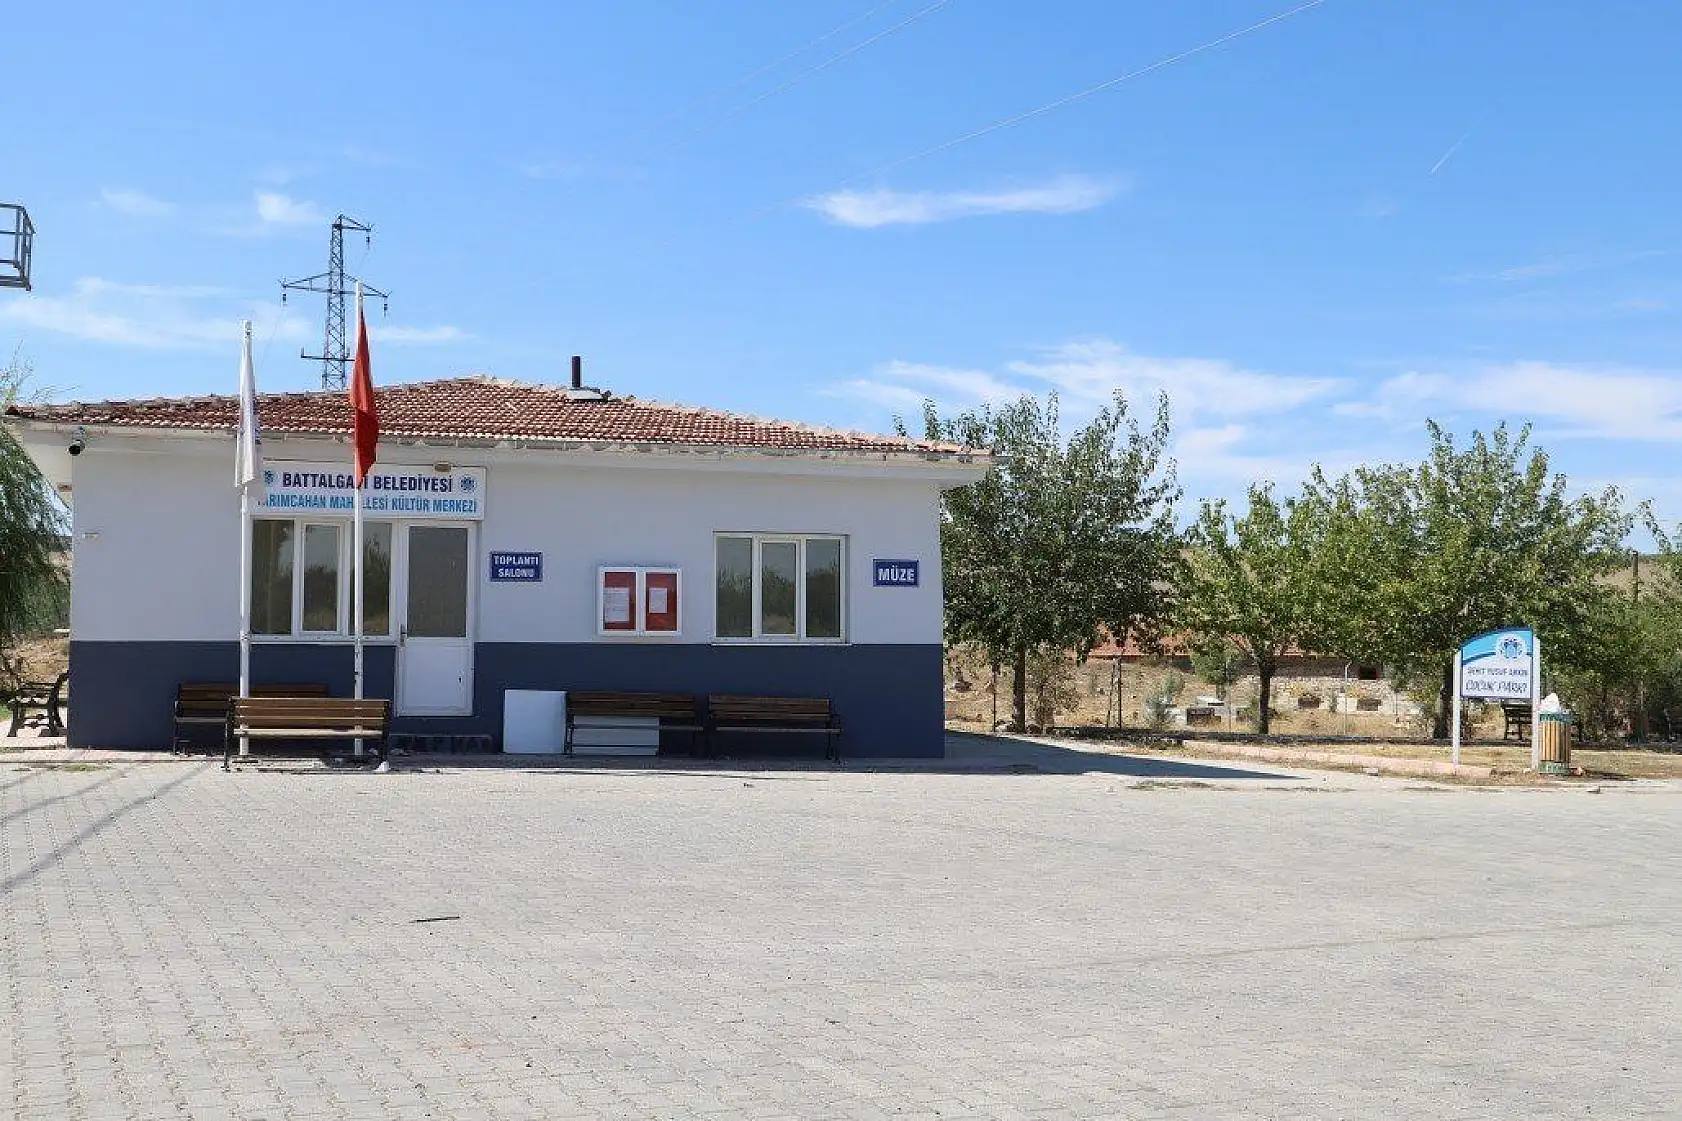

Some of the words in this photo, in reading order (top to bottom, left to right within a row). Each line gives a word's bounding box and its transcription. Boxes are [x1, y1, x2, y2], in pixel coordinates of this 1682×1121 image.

[373, 474, 453, 493] BELEDİYESİ
[391, 495, 430, 513] KÜLTÜR
[493, 555, 539, 565] TOPLANTI
[498, 568, 535, 578] SALONU
[877, 564, 915, 582] MÜZE
